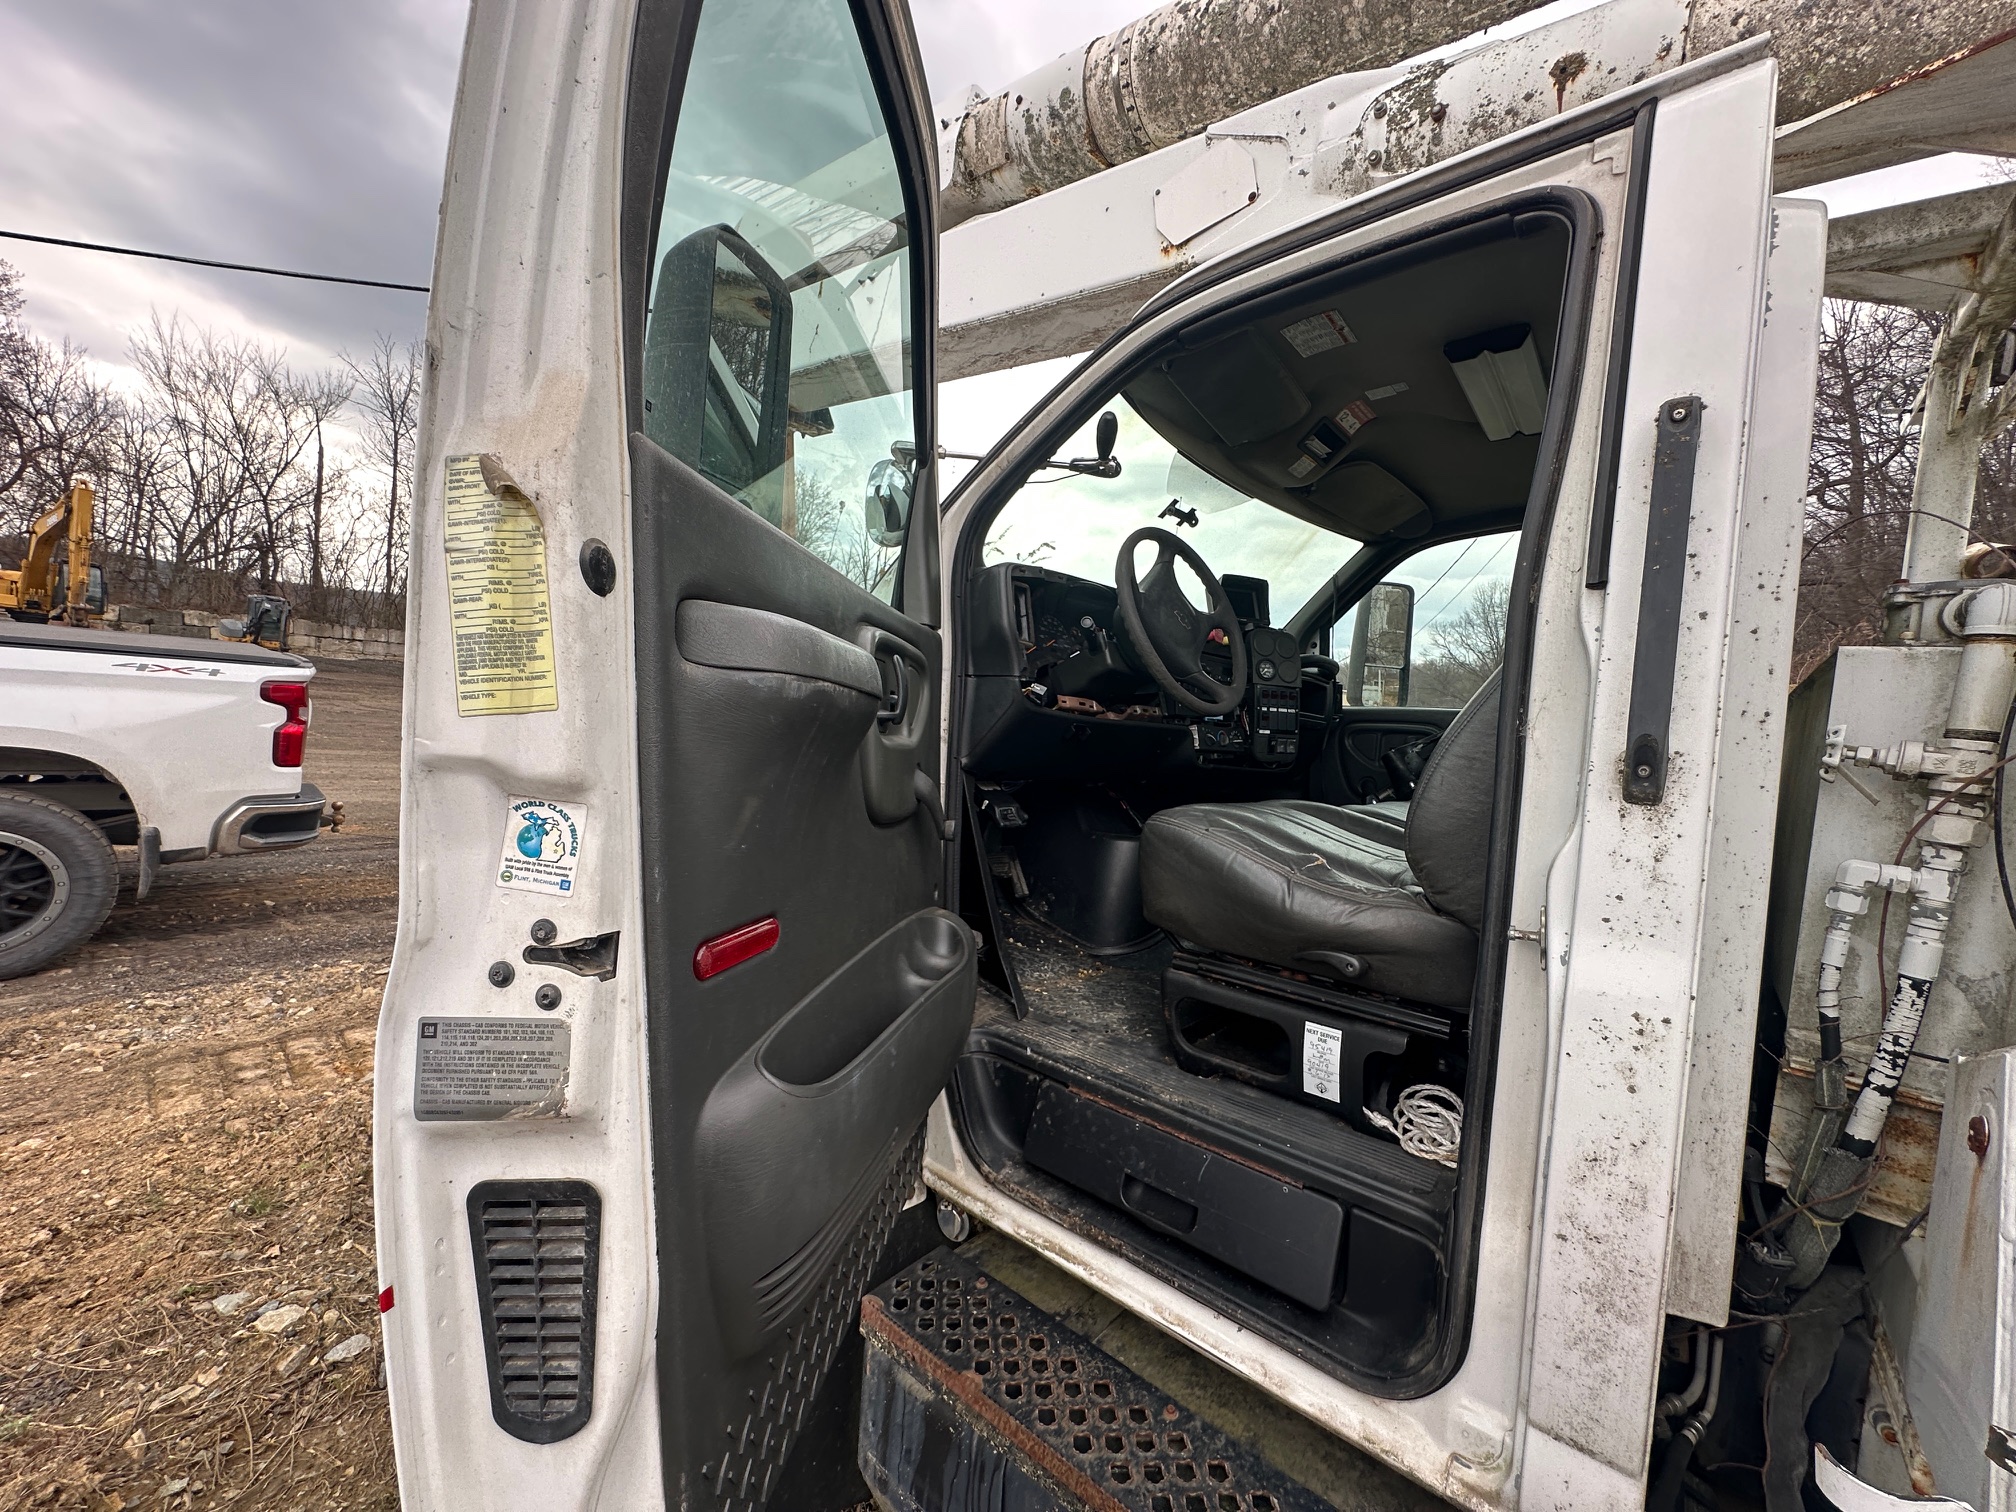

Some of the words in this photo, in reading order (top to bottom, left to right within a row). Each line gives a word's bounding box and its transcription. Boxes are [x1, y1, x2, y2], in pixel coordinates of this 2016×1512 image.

[512, 801, 545, 812] WORLD
[547, 803, 571, 822] CLASS
[568, 822, 579, 857] TRUCKS
[1306, 1028, 1318, 1036] NEXT
[1320, 1031, 1340, 1042] SERVICE
